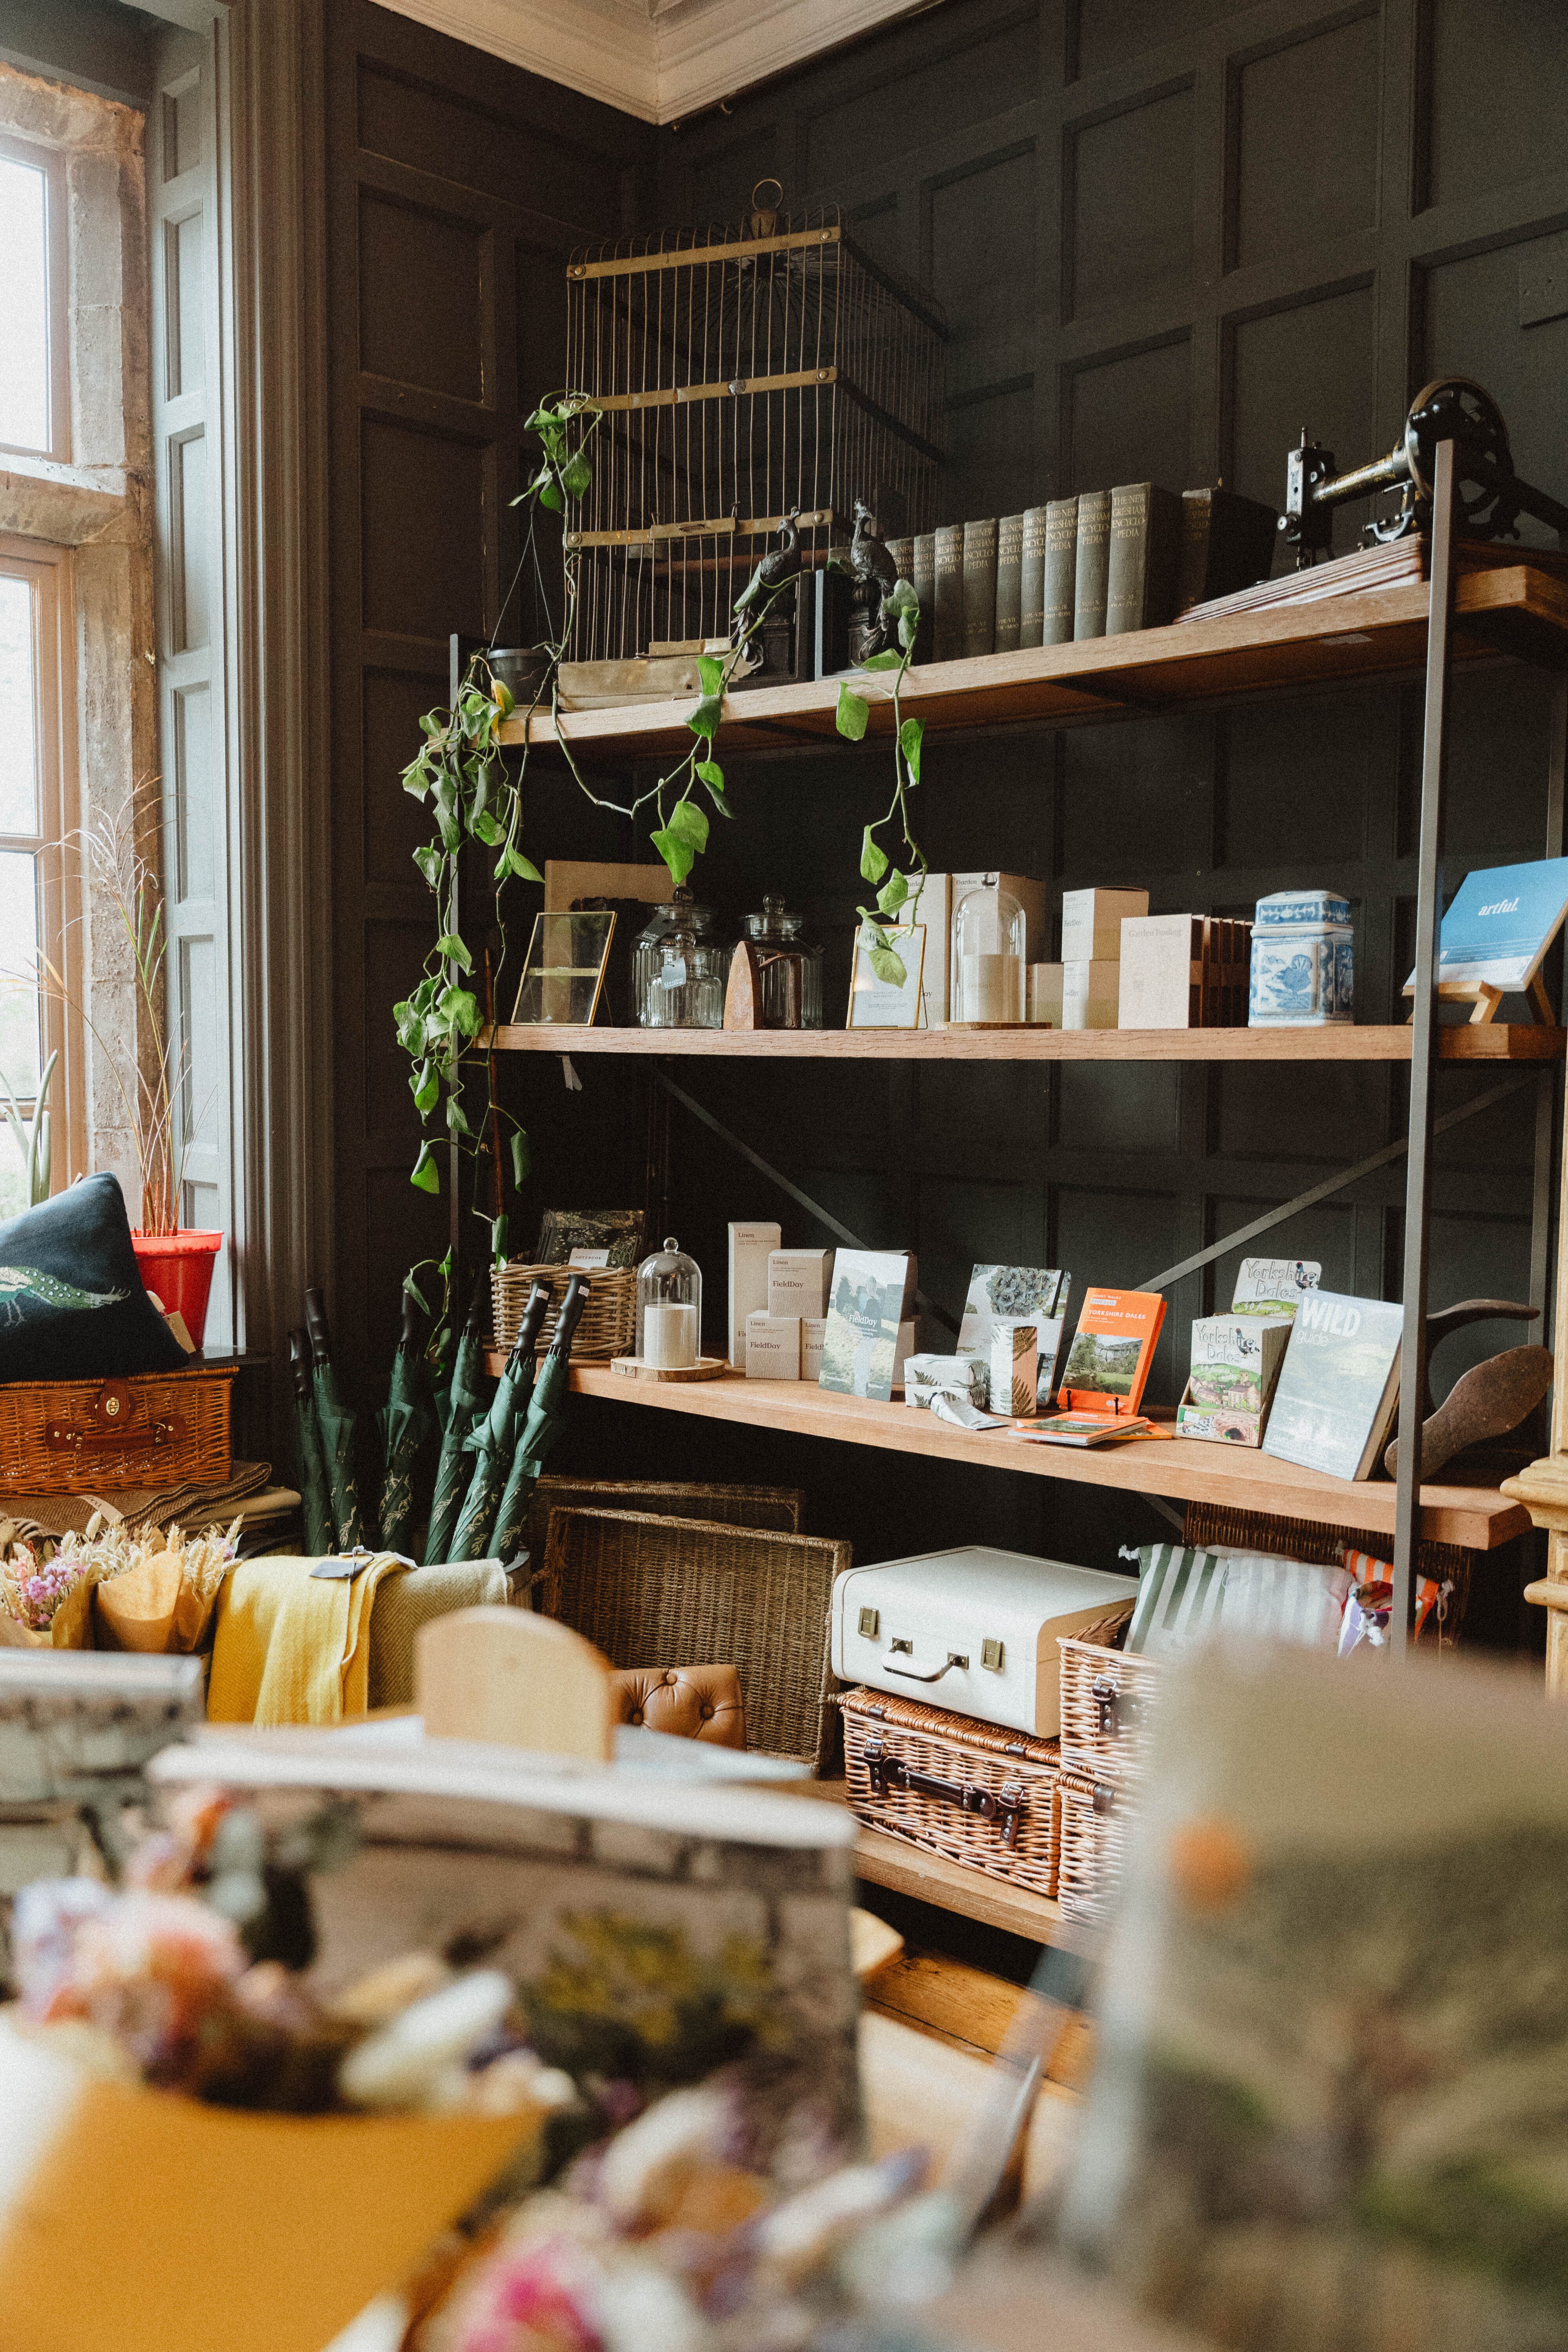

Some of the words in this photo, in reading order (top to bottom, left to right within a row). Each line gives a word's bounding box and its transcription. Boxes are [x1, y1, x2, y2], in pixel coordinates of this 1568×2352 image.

[1112, 505, 1145, 517] GRESHAM
[1036, 516, 1045, 524] NE
[1078, 512, 1110, 524] GRESHAM
[1047, 519, 1077, 530] GRESHAM
[1023, 527, 1045, 538] GRESHA
[964, 538, 995, 550] GRESHAM
[1023, 538, 1045, 549] ENCYCL
[999, 544, 1022, 555] NCYCLO
[1156, 928, 1181, 936] Trading
[664, 977, 683, 985] Garden
[1246, 1259, 1317, 1281] Yorkshire
[773, 1280, 804, 1289] FieldDay
[1256, 1279, 1297, 1299] Dales
[1089, 1309, 1124, 1318] YORKSHIRE
[1301, 1296, 1361, 1337] WILD
[849, 1314, 878, 1328] FieldDay
[1196, 1323, 1254, 1348] Yorkshire
[1296, 1330, 1328, 1347] guide
[750, 1341, 781, 1350] FieldDay
[1207, 1343, 1241, 1363] Dales
